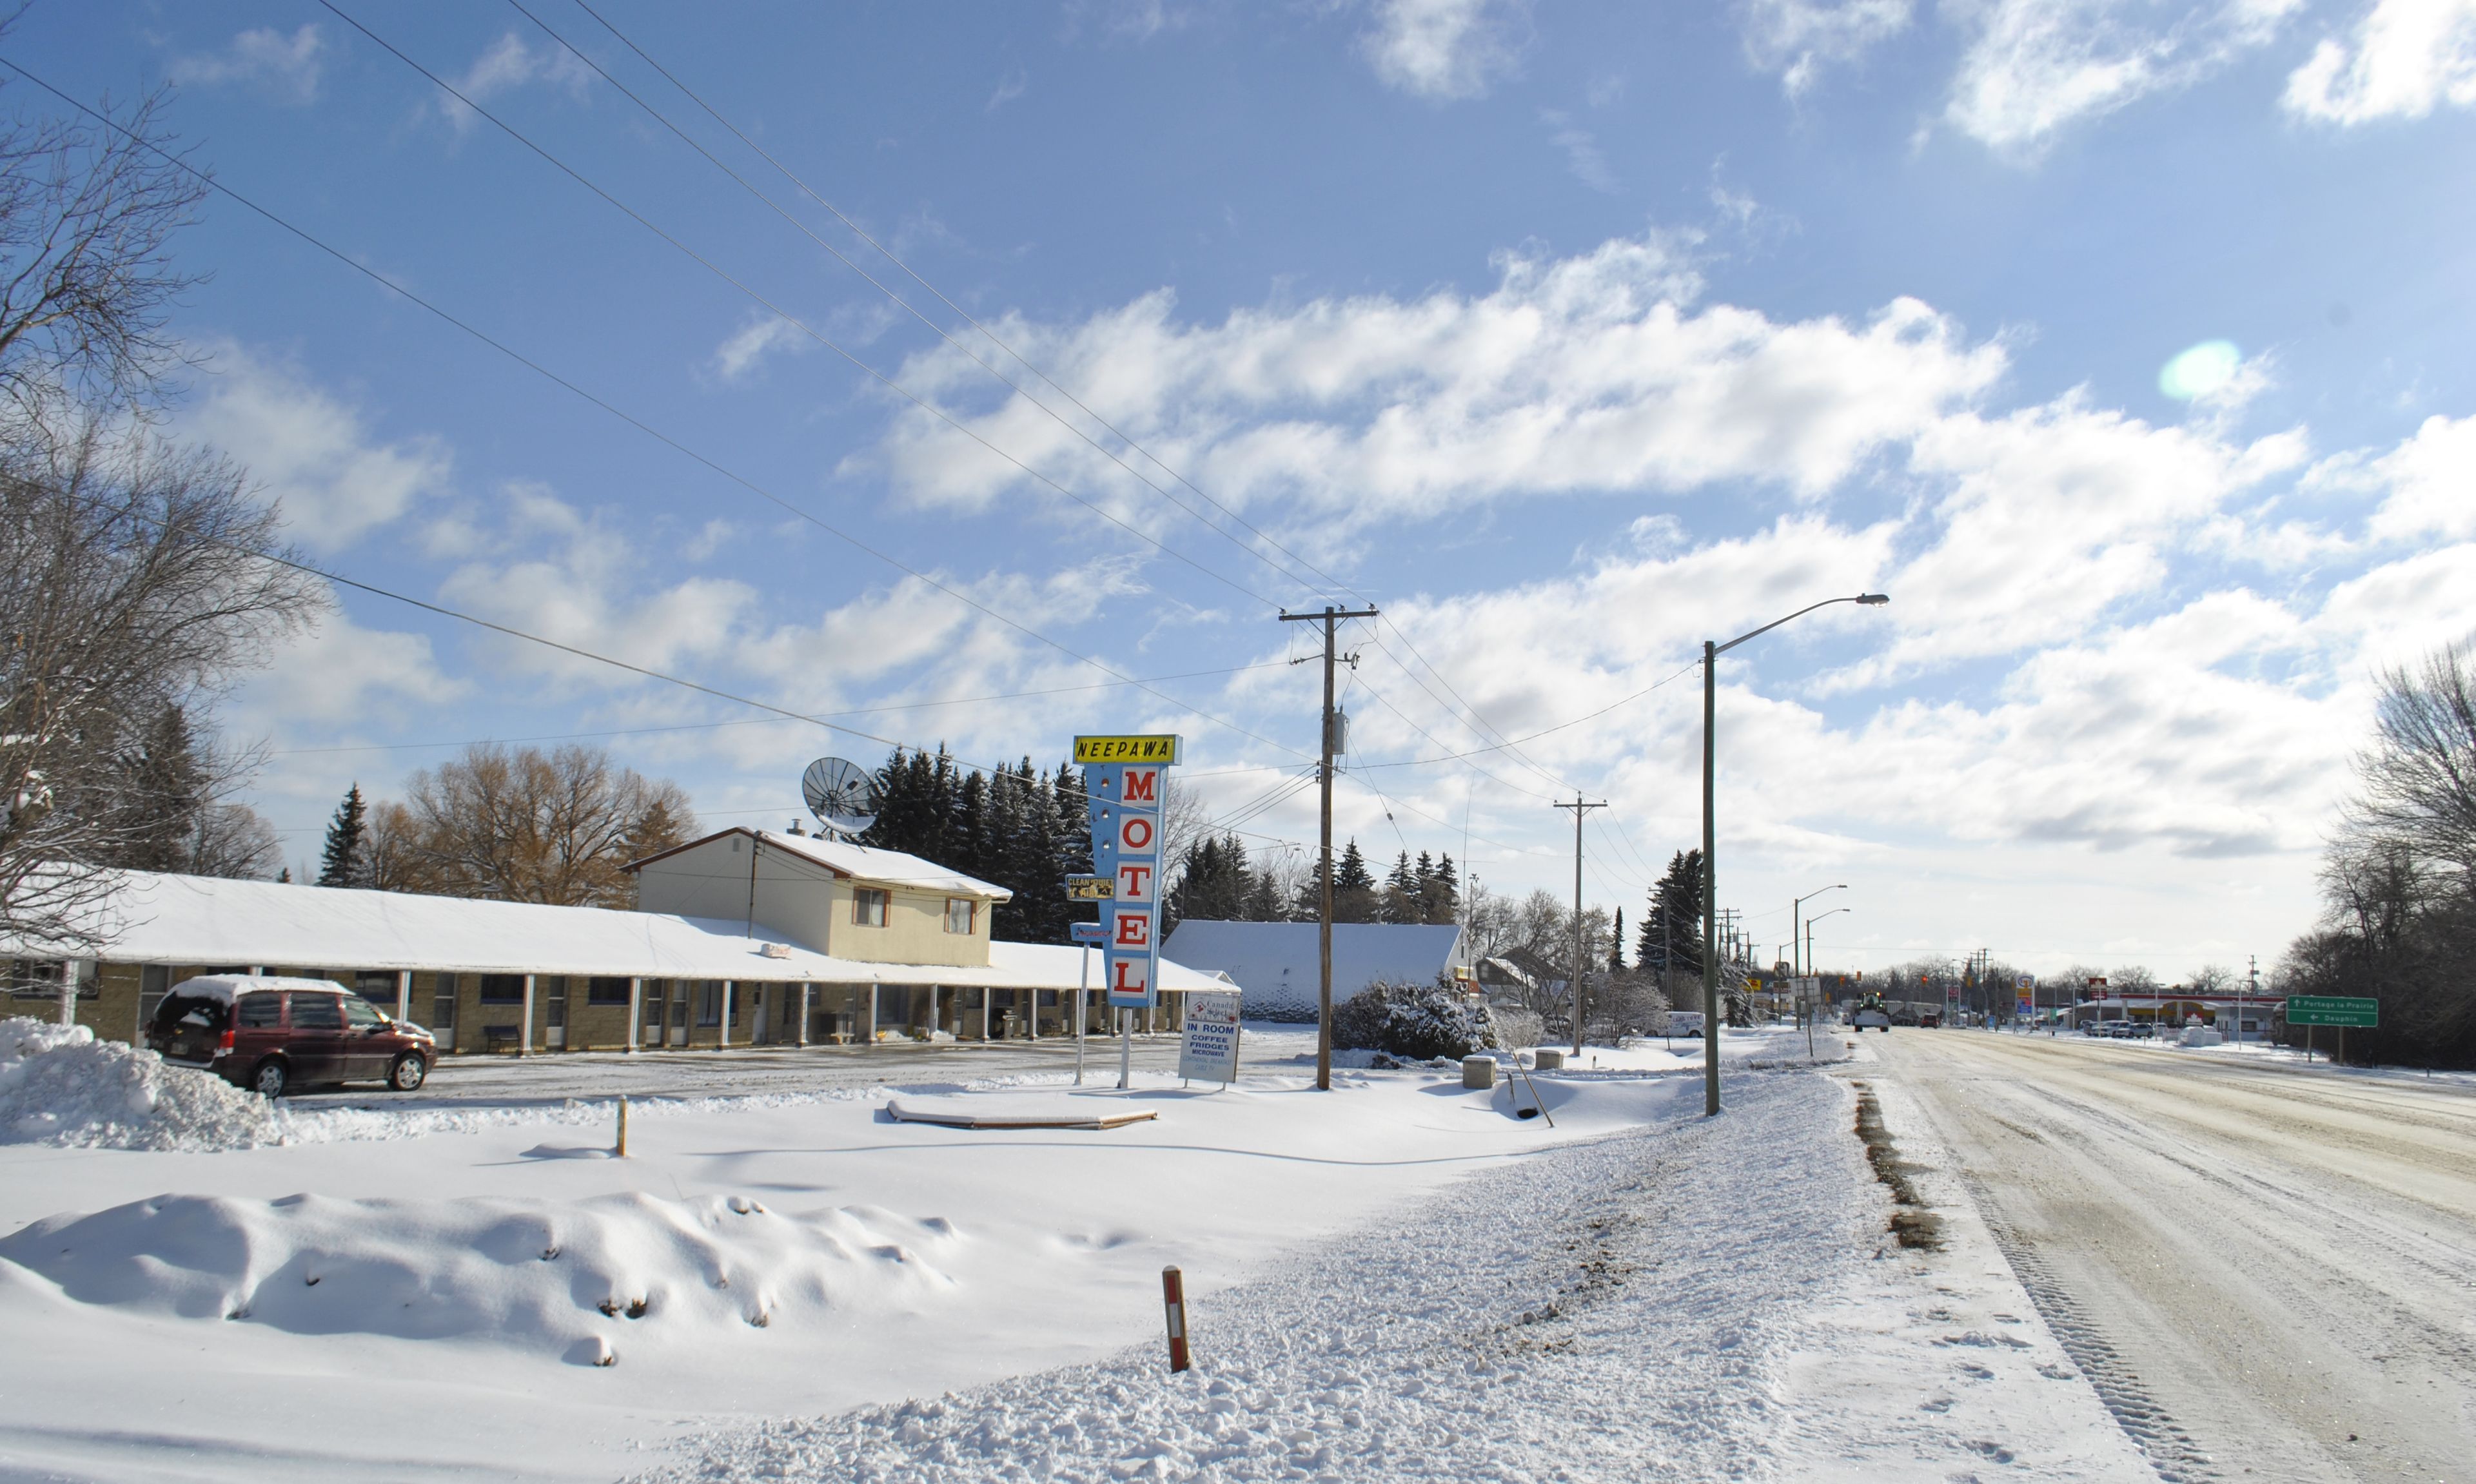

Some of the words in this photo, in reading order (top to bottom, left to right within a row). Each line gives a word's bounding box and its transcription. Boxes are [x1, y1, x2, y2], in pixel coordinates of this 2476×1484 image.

[1077, 741, 1168, 757] NEEPAWA
[1068, 878, 1090, 886] CLEAN
[1114, 772, 1155, 993] MOTEL
[2304, 1001, 2334, 1009] Portage
[1187, 1023, 1197, 1031] IN
[1203, 1024, 1234, 1035] ROOM
[1192, 1034, 1228, 1043] COFFEE
[1190, 1042, 1230, 1051] FRIDGES
[1192, 1049, 1225, 1057] MICROWAVE
